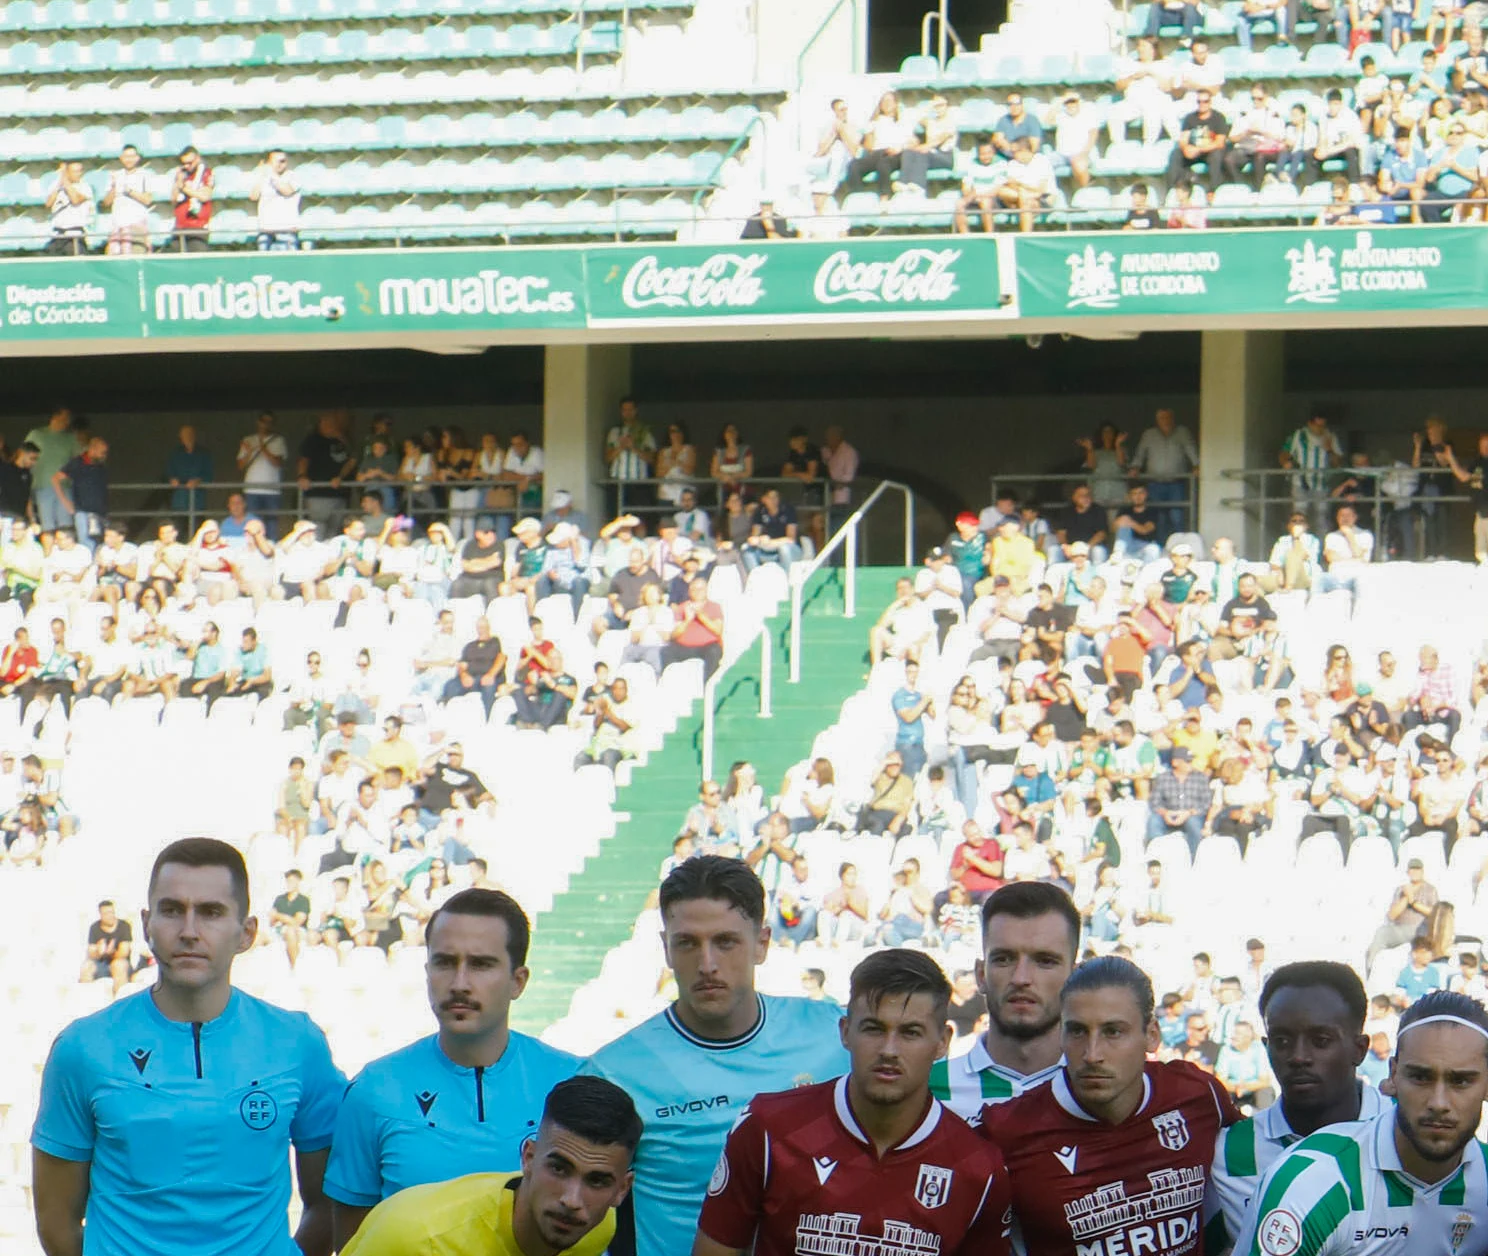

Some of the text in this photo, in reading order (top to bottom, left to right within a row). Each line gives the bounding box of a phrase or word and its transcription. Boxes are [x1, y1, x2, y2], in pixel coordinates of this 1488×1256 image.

[622, 253, 768, 309] Coca-Cola
[813, 248, 963, 304] Coca-Cola
[1121, 276, 1139, 296] DE
[1341, 271, 1359, 291] DE
[8, 305, 108, 324] de Córdoba
[655, 1095, 729, 1118] GIVOVA
